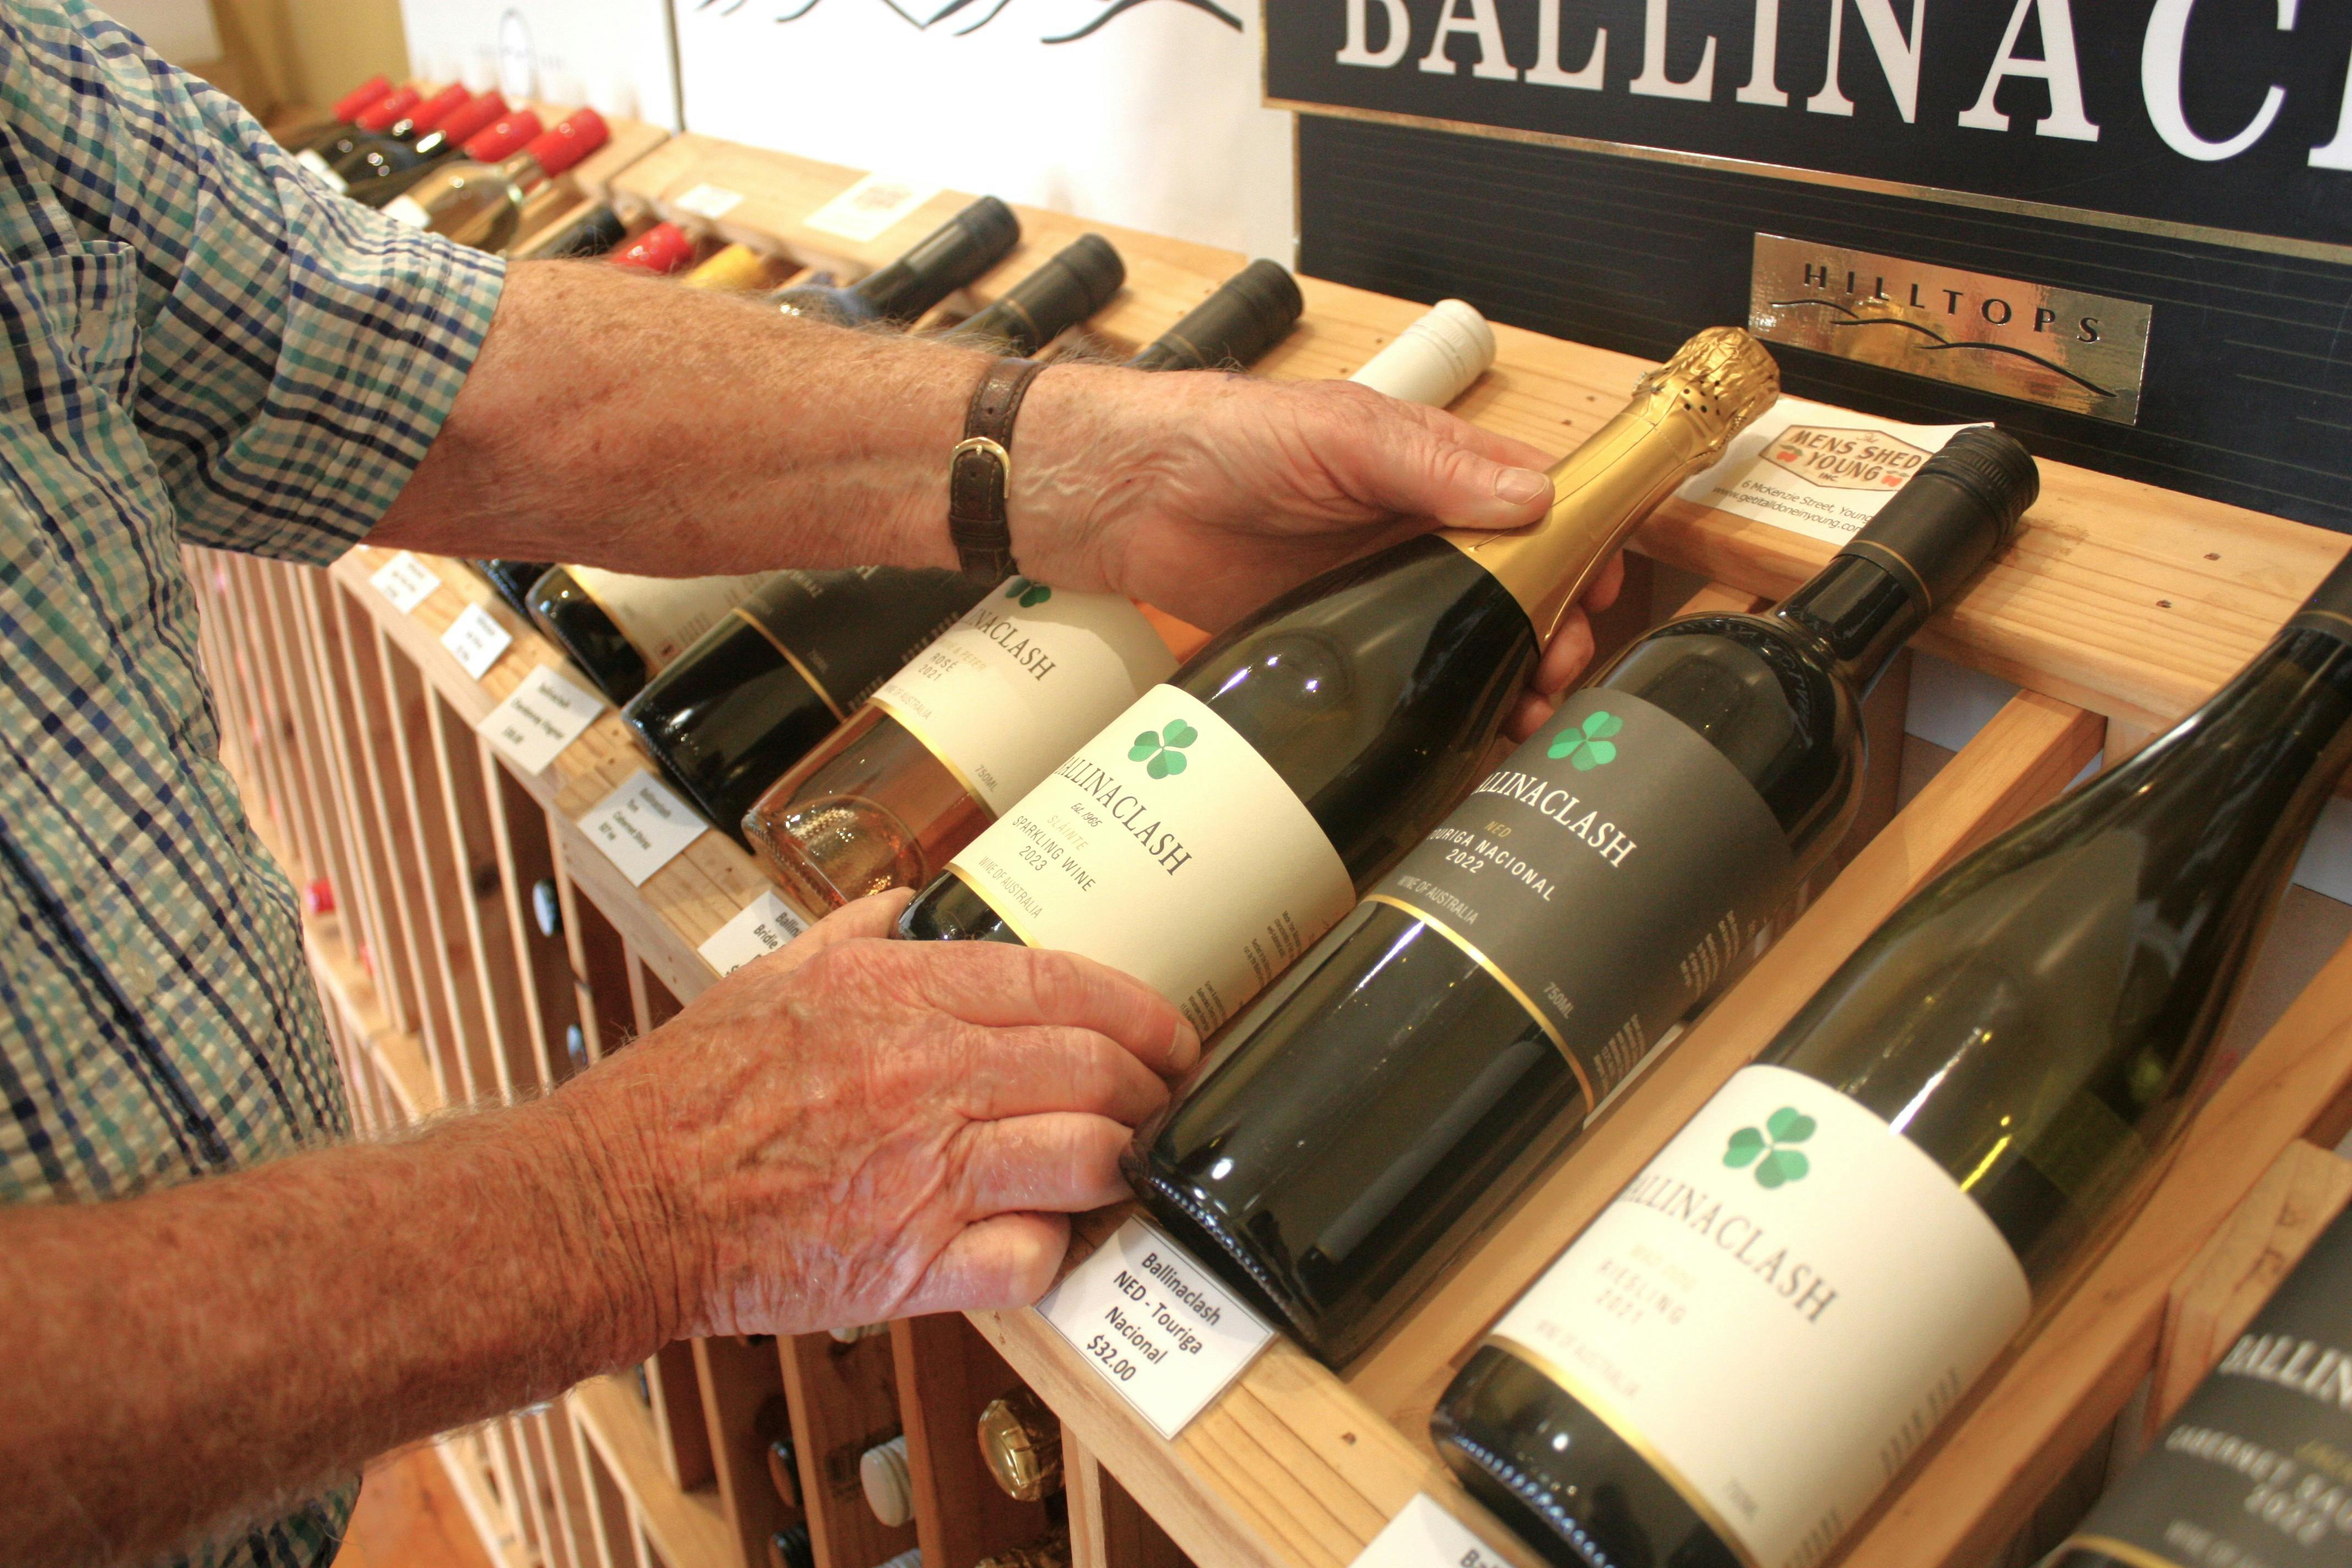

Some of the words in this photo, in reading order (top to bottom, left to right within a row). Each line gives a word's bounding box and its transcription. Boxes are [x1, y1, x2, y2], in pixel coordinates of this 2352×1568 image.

[1804, 263, 2100, 344] HILLTOPS
[1791, 430, 1857, 454] MENS
[1858, 445, 1922, 469] SHED
[1805, 451, 1883, 481] YOUNG
[1741, 480, 1751, 488] 6
[1751, 482, 1801, 502] McKenzie
[1799, 497, 1835, 513] Street,
[1839, 507, 1874, 524] Young
[918, 664, 943, 682] 2021
[930, 652, 959, 673] ROSÉ
[959, 650, 987, 673] PETER
[974, 764, 998, 793] 750ML
[1053, 756, 1193, 876] ALLINACLASH
[1082, 812, 1103, 827] 1965
[1471, 771, 1638, 869] ALLINACLASH
[1485, 821, 1512, 838] NED
[1012, 815, 1064, 860] SPARKLING
[1061, 856, 1097, 892] WINE
[1019, 845, 1048, 871] 2023
[1445, 848, 1484, 874] 2022
[1475, 840, 1555, 902] NACIONAL
[978, 855, 999, 874] WINE
[992, 868, 1007, 881] OF
[1001, 876, 1043, 919] AUSTRALIA
[1415, 881, 1433, 894] OF
[1425, 887, 1479, 926] AUSTRALIA
[753, 923, 778, 949] Bridie
[775, 911, 803, 938] Ballin
[1543, 982, 1574, 1020] 750ML
[1141, 1251, 1222, 1327] Ballinaclash
[1113, 1270, 1147, 1302] NED
[1151, 1303, 1204, 1356] Touriga
[1104, 1306, 1168, 1365] Nacional
[1086, 1333, 1137, 1382] $32.00
